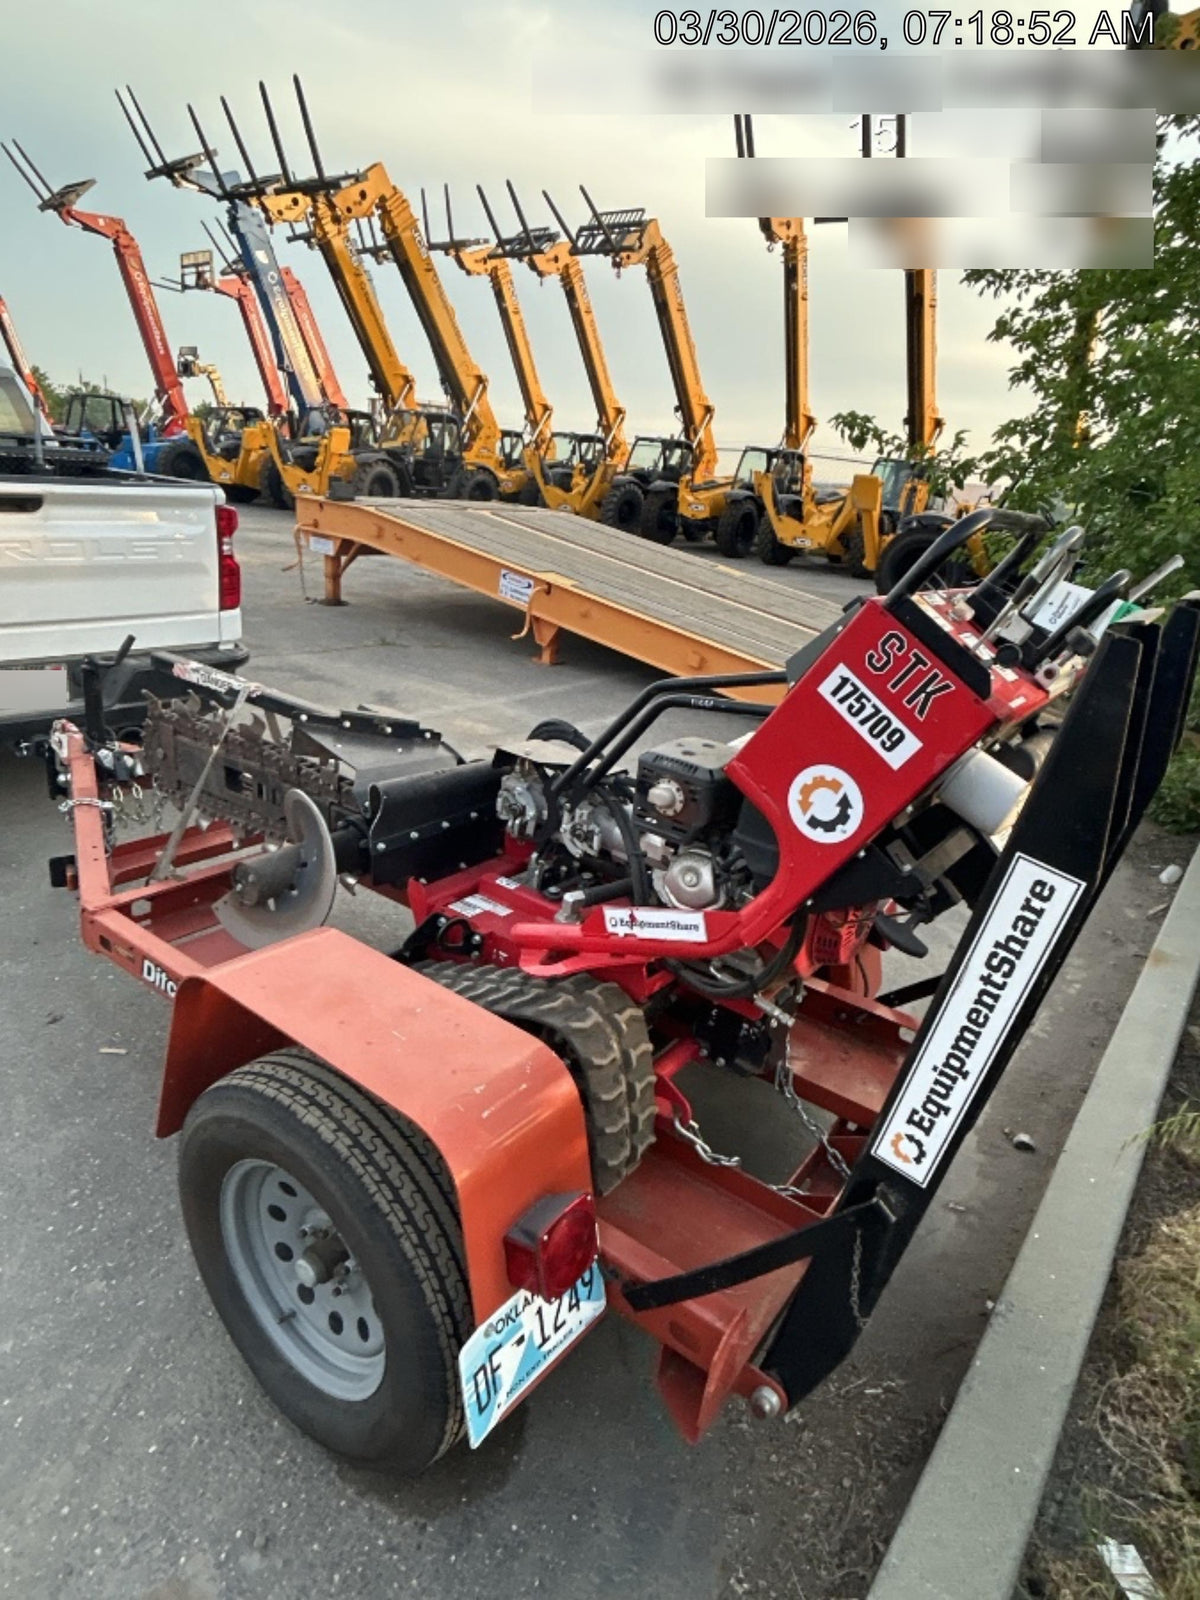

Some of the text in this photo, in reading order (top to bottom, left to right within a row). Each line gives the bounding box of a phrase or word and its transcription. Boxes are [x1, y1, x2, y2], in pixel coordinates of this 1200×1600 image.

[829, 673, 907, 753] 175709
[865, 630, 956, 722] STK
[619, 917, 700, 932] EqpmentShare
[906, 878, 1056, 1138] EquipmentShare
